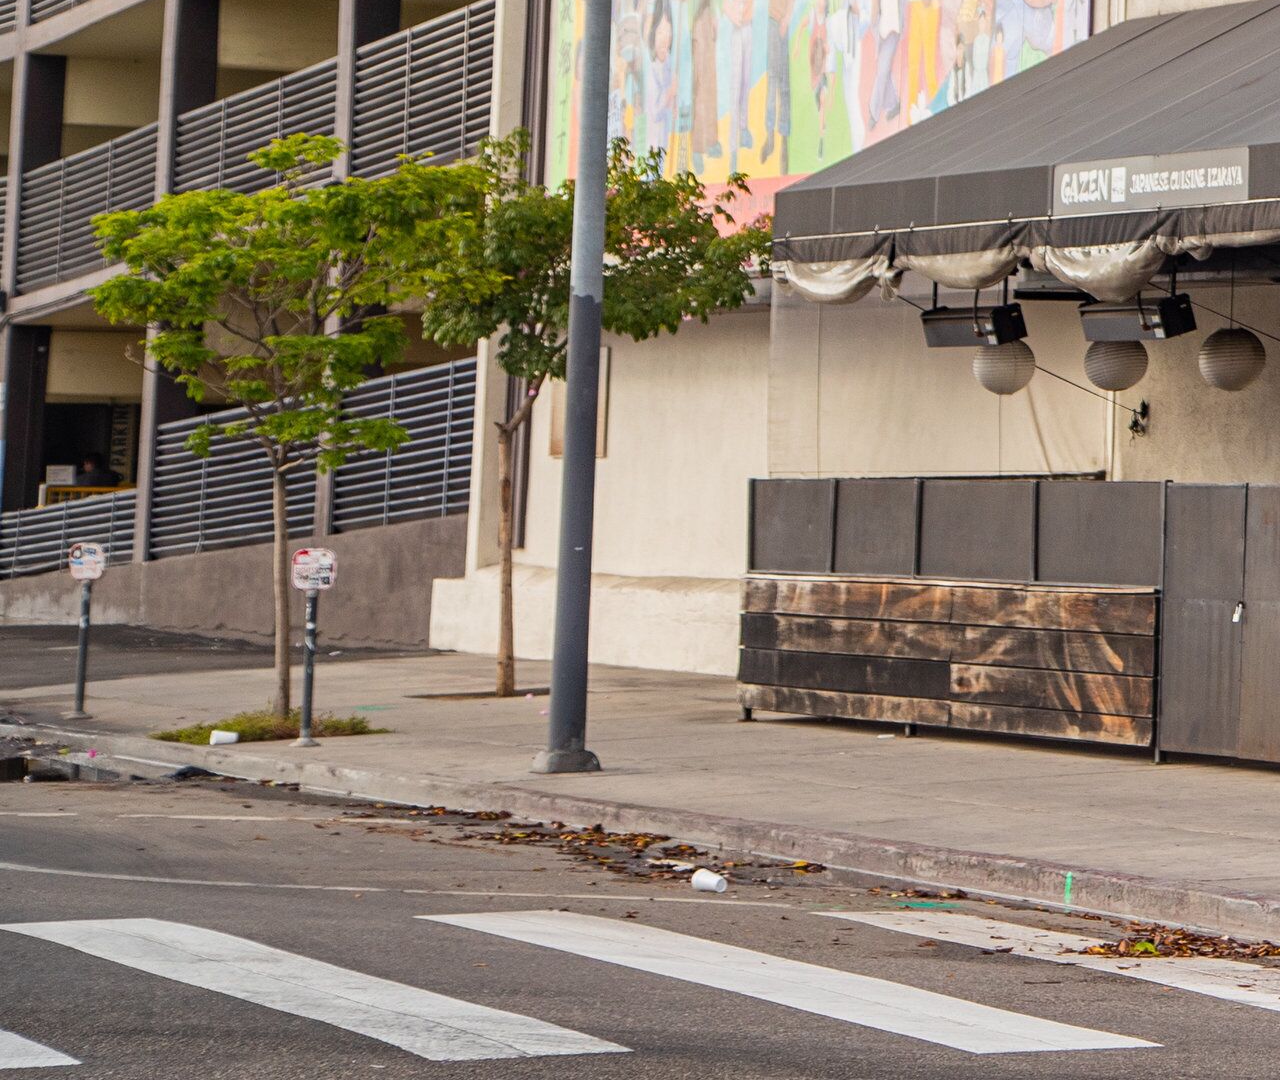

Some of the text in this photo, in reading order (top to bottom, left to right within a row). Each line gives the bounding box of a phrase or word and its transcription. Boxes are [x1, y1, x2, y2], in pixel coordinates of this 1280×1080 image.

[1060, 168, 1109, 205] GAZEN
[1130, 170, 1170, 194] JAPANESE
[1170, 167, 1206, 191] CUISINE
[1207, 165, 1244, 187] IZAKAYA
